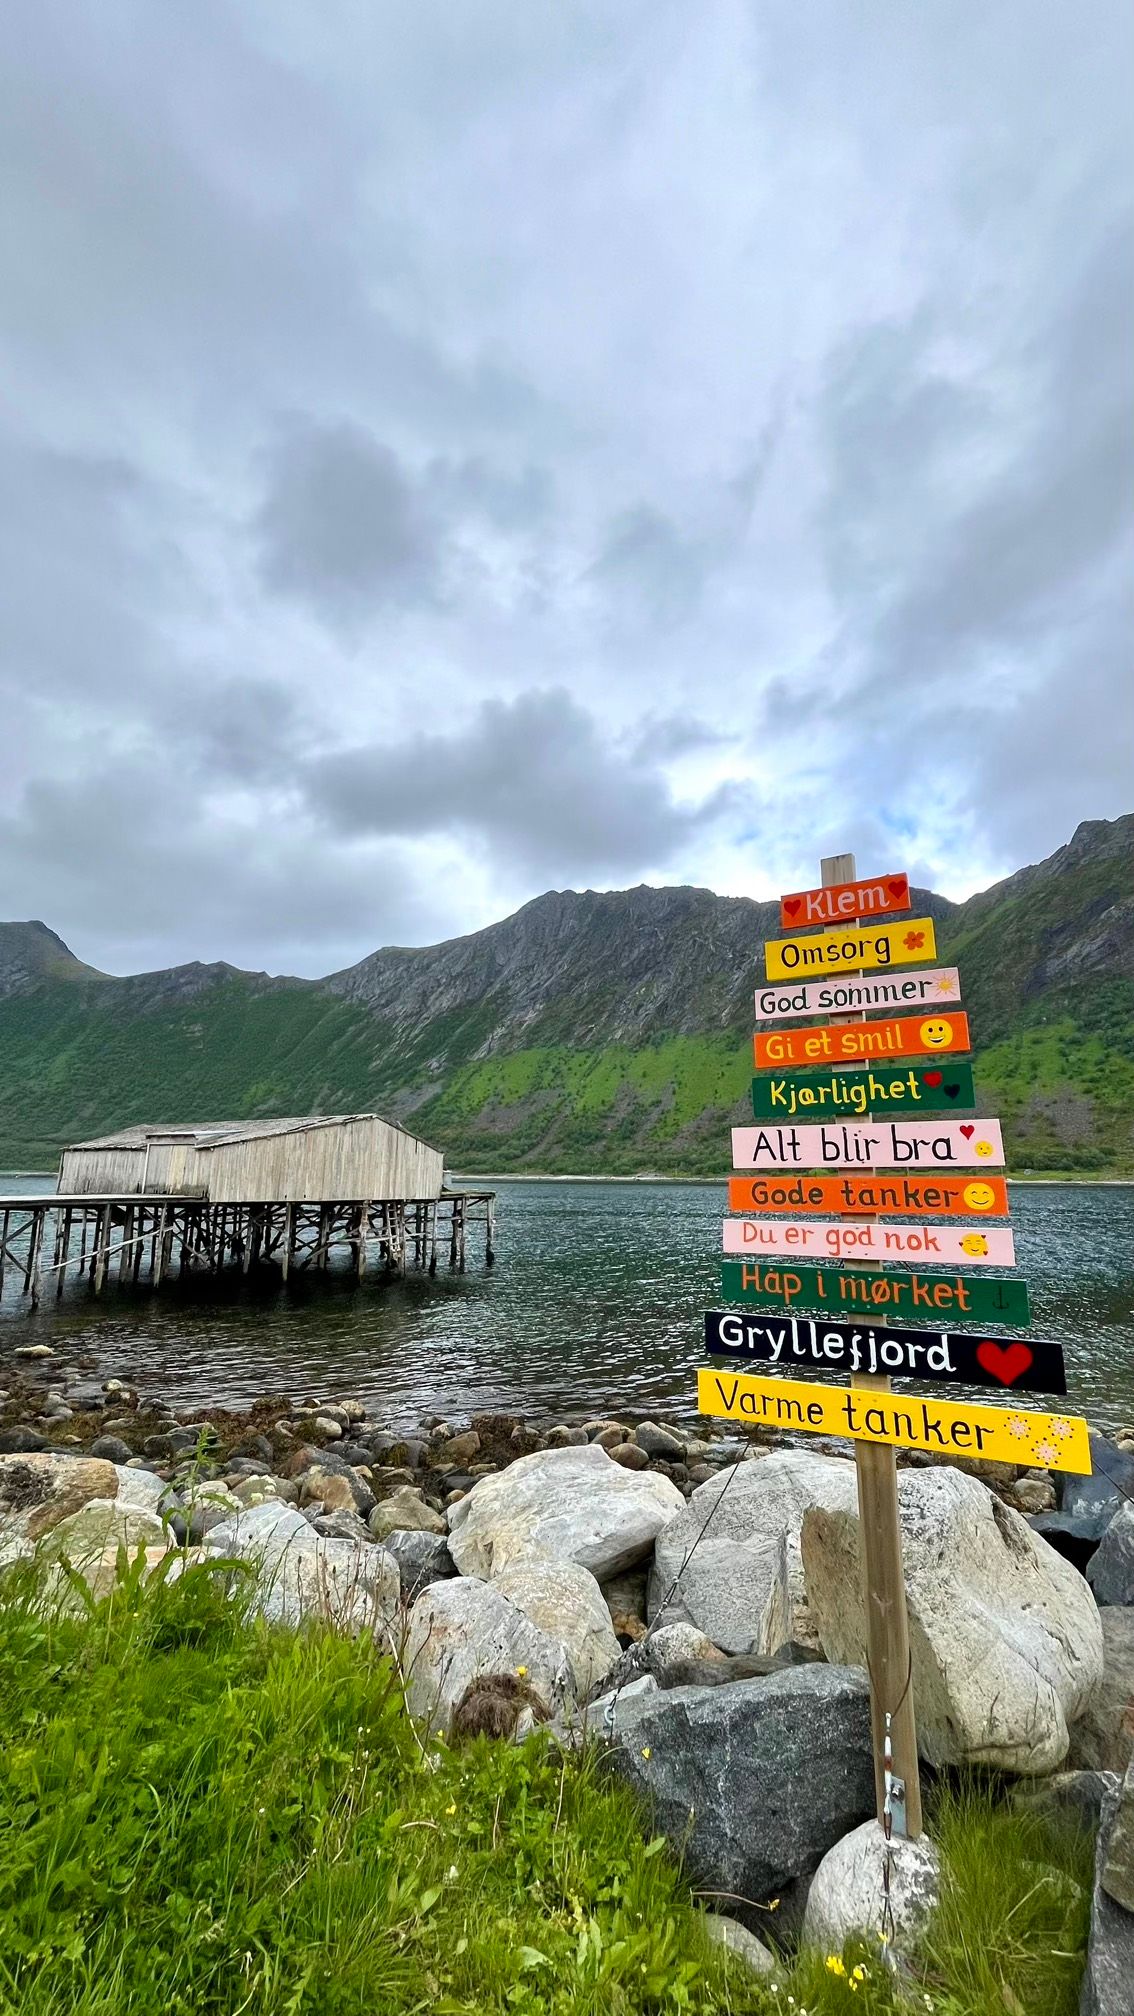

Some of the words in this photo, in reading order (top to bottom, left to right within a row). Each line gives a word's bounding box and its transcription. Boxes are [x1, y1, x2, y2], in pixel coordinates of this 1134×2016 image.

[806, 885, 890, 920] Klem
[781, 936, 890, 967] Omsorg
[760, 987, 809, 1014] God
[818, 979, 933, 1008] sommer
[766, 1035, 794, 1059] Gi
[805, 1031, 832, 1056] et
[842, 1025, 903, 1053] smil
[752, 1129, 801, 1162] Alt
[821, 1127, 880, 1162] blir
[891, 1124, 957, 1161] bra
[751, 1181, 823, 1205] Gode
[841, 1181, 960, 1208] tanker
[743, 1222, 777, 1244] Du
[785, 1228, 814, 1245] er
[826, 1227, 873, 1255] god
[885, 1228, 941, 1251] nok
[742, 1265, 802, 1304] Håp
[817, 1273, 827, 1297] i
[840, 1275, 972, 1311] mørket
[719, 1315, 956, 1373] Gryllefjord
[716, 1378, 824, 1424] Varme
[842, 1394, 995, 1451] tanker
